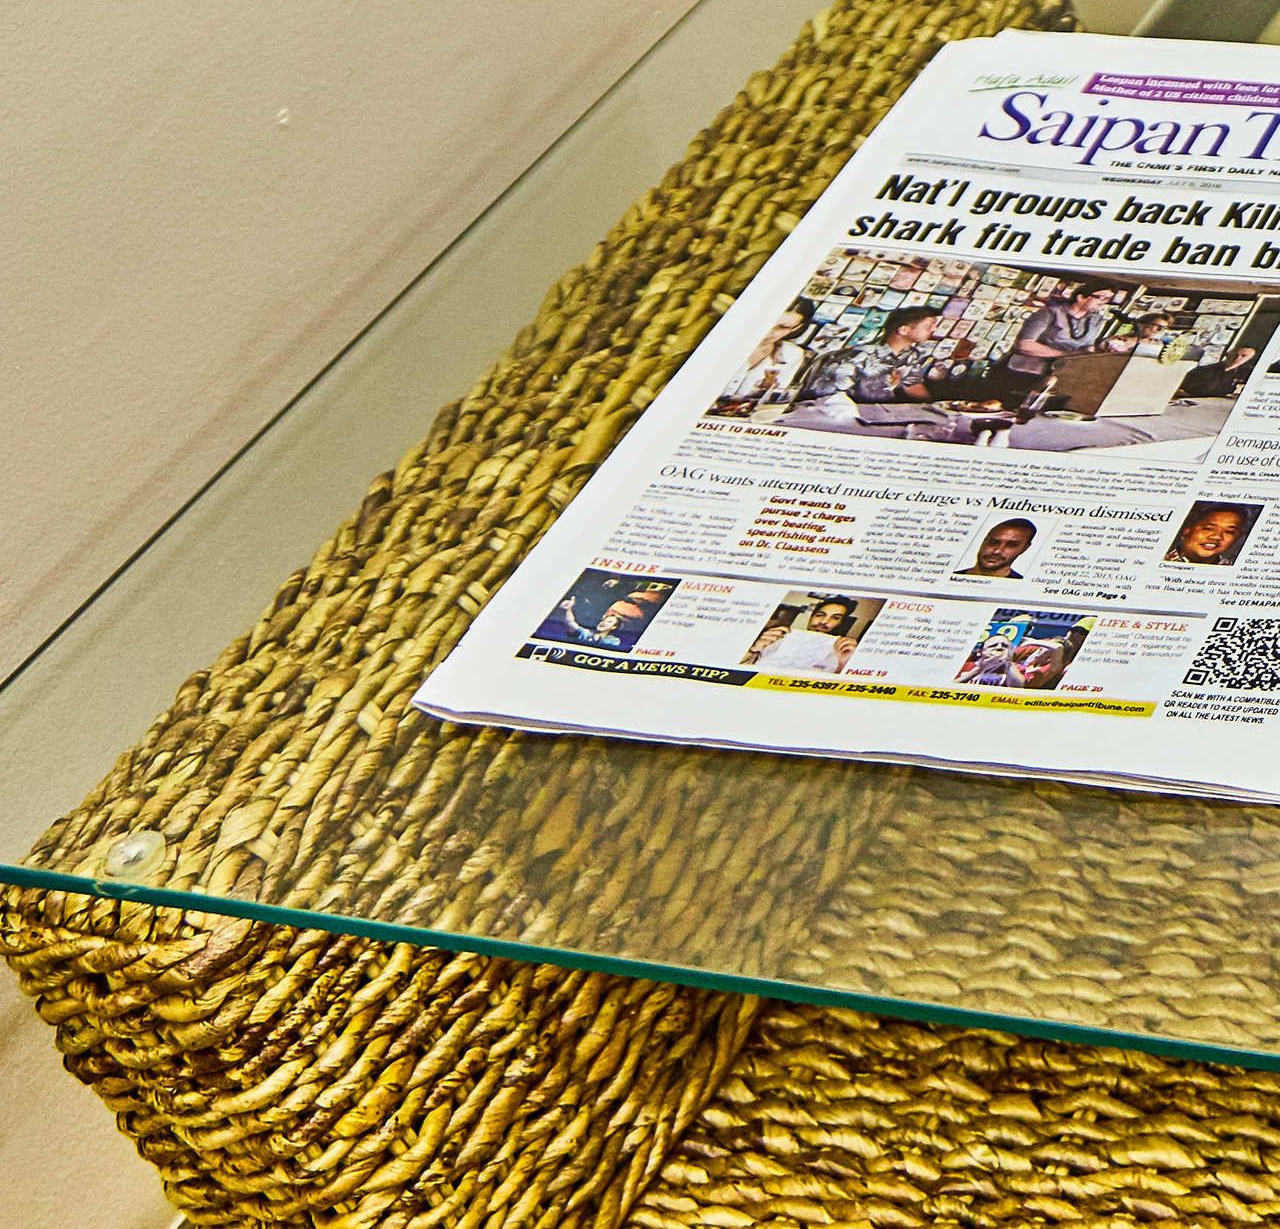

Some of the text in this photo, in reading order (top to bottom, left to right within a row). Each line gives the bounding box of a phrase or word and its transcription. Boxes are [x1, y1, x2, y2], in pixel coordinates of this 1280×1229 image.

[977, 92, 1230, 165] Saipan
[1110, 160, 1133, 168] THE
[1137, 162, 1183, 171] CNMI'S
[1228, 167, 1265, 175] DAILY
[874, 174, 970, 207] Nat'l
[969, 187, 1107, 222] groups
[1113, 196, 1212, 226] back
[848, 212, 966, 245] shark
[974, 223, 1031, 252] fin
[1042, 229, 1151, 261] trade
[1161, 235, 1240, 266] ban
[1217, 454, 1235, 465] on
[1237, 456, 1259, 465] use
[1260, 454, 1275, 467] of
[660, 465, 1174, 522] OAG wants attempted murder charge vs Mathewson dismissed
[591, 557, 660, 573] INSIDE
[682, 581, 734, 594] NATION
[888, 601, 934, 613] FOCUS
[1220, 598, 1237, 606] See
[1099, 619, 1190, 632] LIFE & STYLE
[573, 655, 729, 679] GOT A NEWS TIP?
[845, 668, 875, 676] PAGE
[1060, 684, 1102, 693] PAGE 20
[929, 691, 980, 702] 235-3740
[1171, 691, 1193, 699] SCAN
[1194, 692, 1206, 700] ME
[1207, 693, 1225, 701] WITH
[1234, 696, 1280, 706] COMPATIBLE
[1024, 700, 1144, 713] editor@saipantribune.com
[1177, 701, 1279, 715] READER TO KEEP UPDATED
[1179, 711, 1192, 719] ALL
[1195, 712, 1210, 720] THE
[1212, 713, 1240, 722] LATEST
